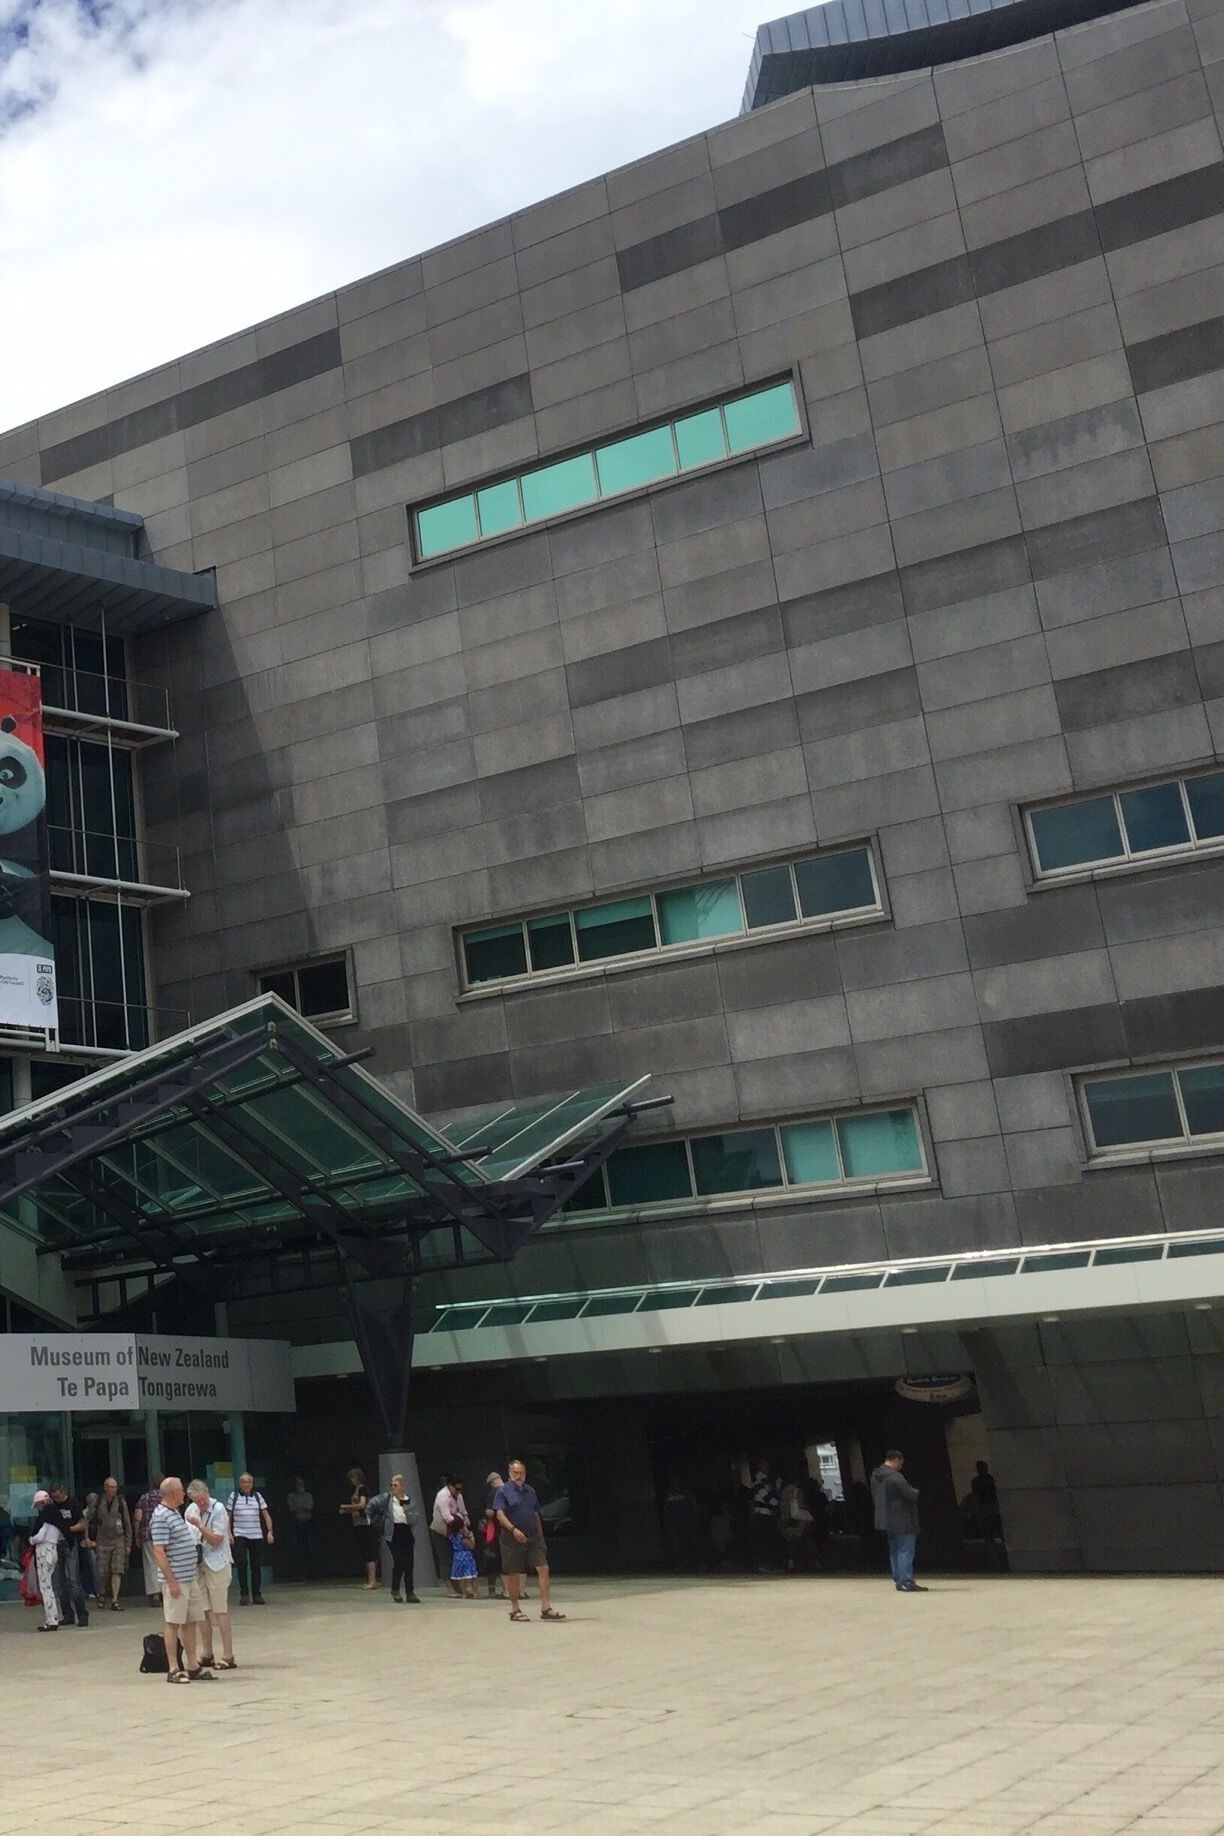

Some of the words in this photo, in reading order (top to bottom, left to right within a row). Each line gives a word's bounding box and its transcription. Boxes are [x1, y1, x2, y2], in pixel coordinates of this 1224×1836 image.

[31, 1346, 111, 1367] Museum
[117, 1346, 133, 1366] of
[139, 1346, 172, 1367] New
[175, 1348, 229, 1369] Zealand
[57, 1377, 78, 1397] Te
[84, 1377, 129, 1401] Papa
[140, 1376, 217, 1402] Tongarewa
